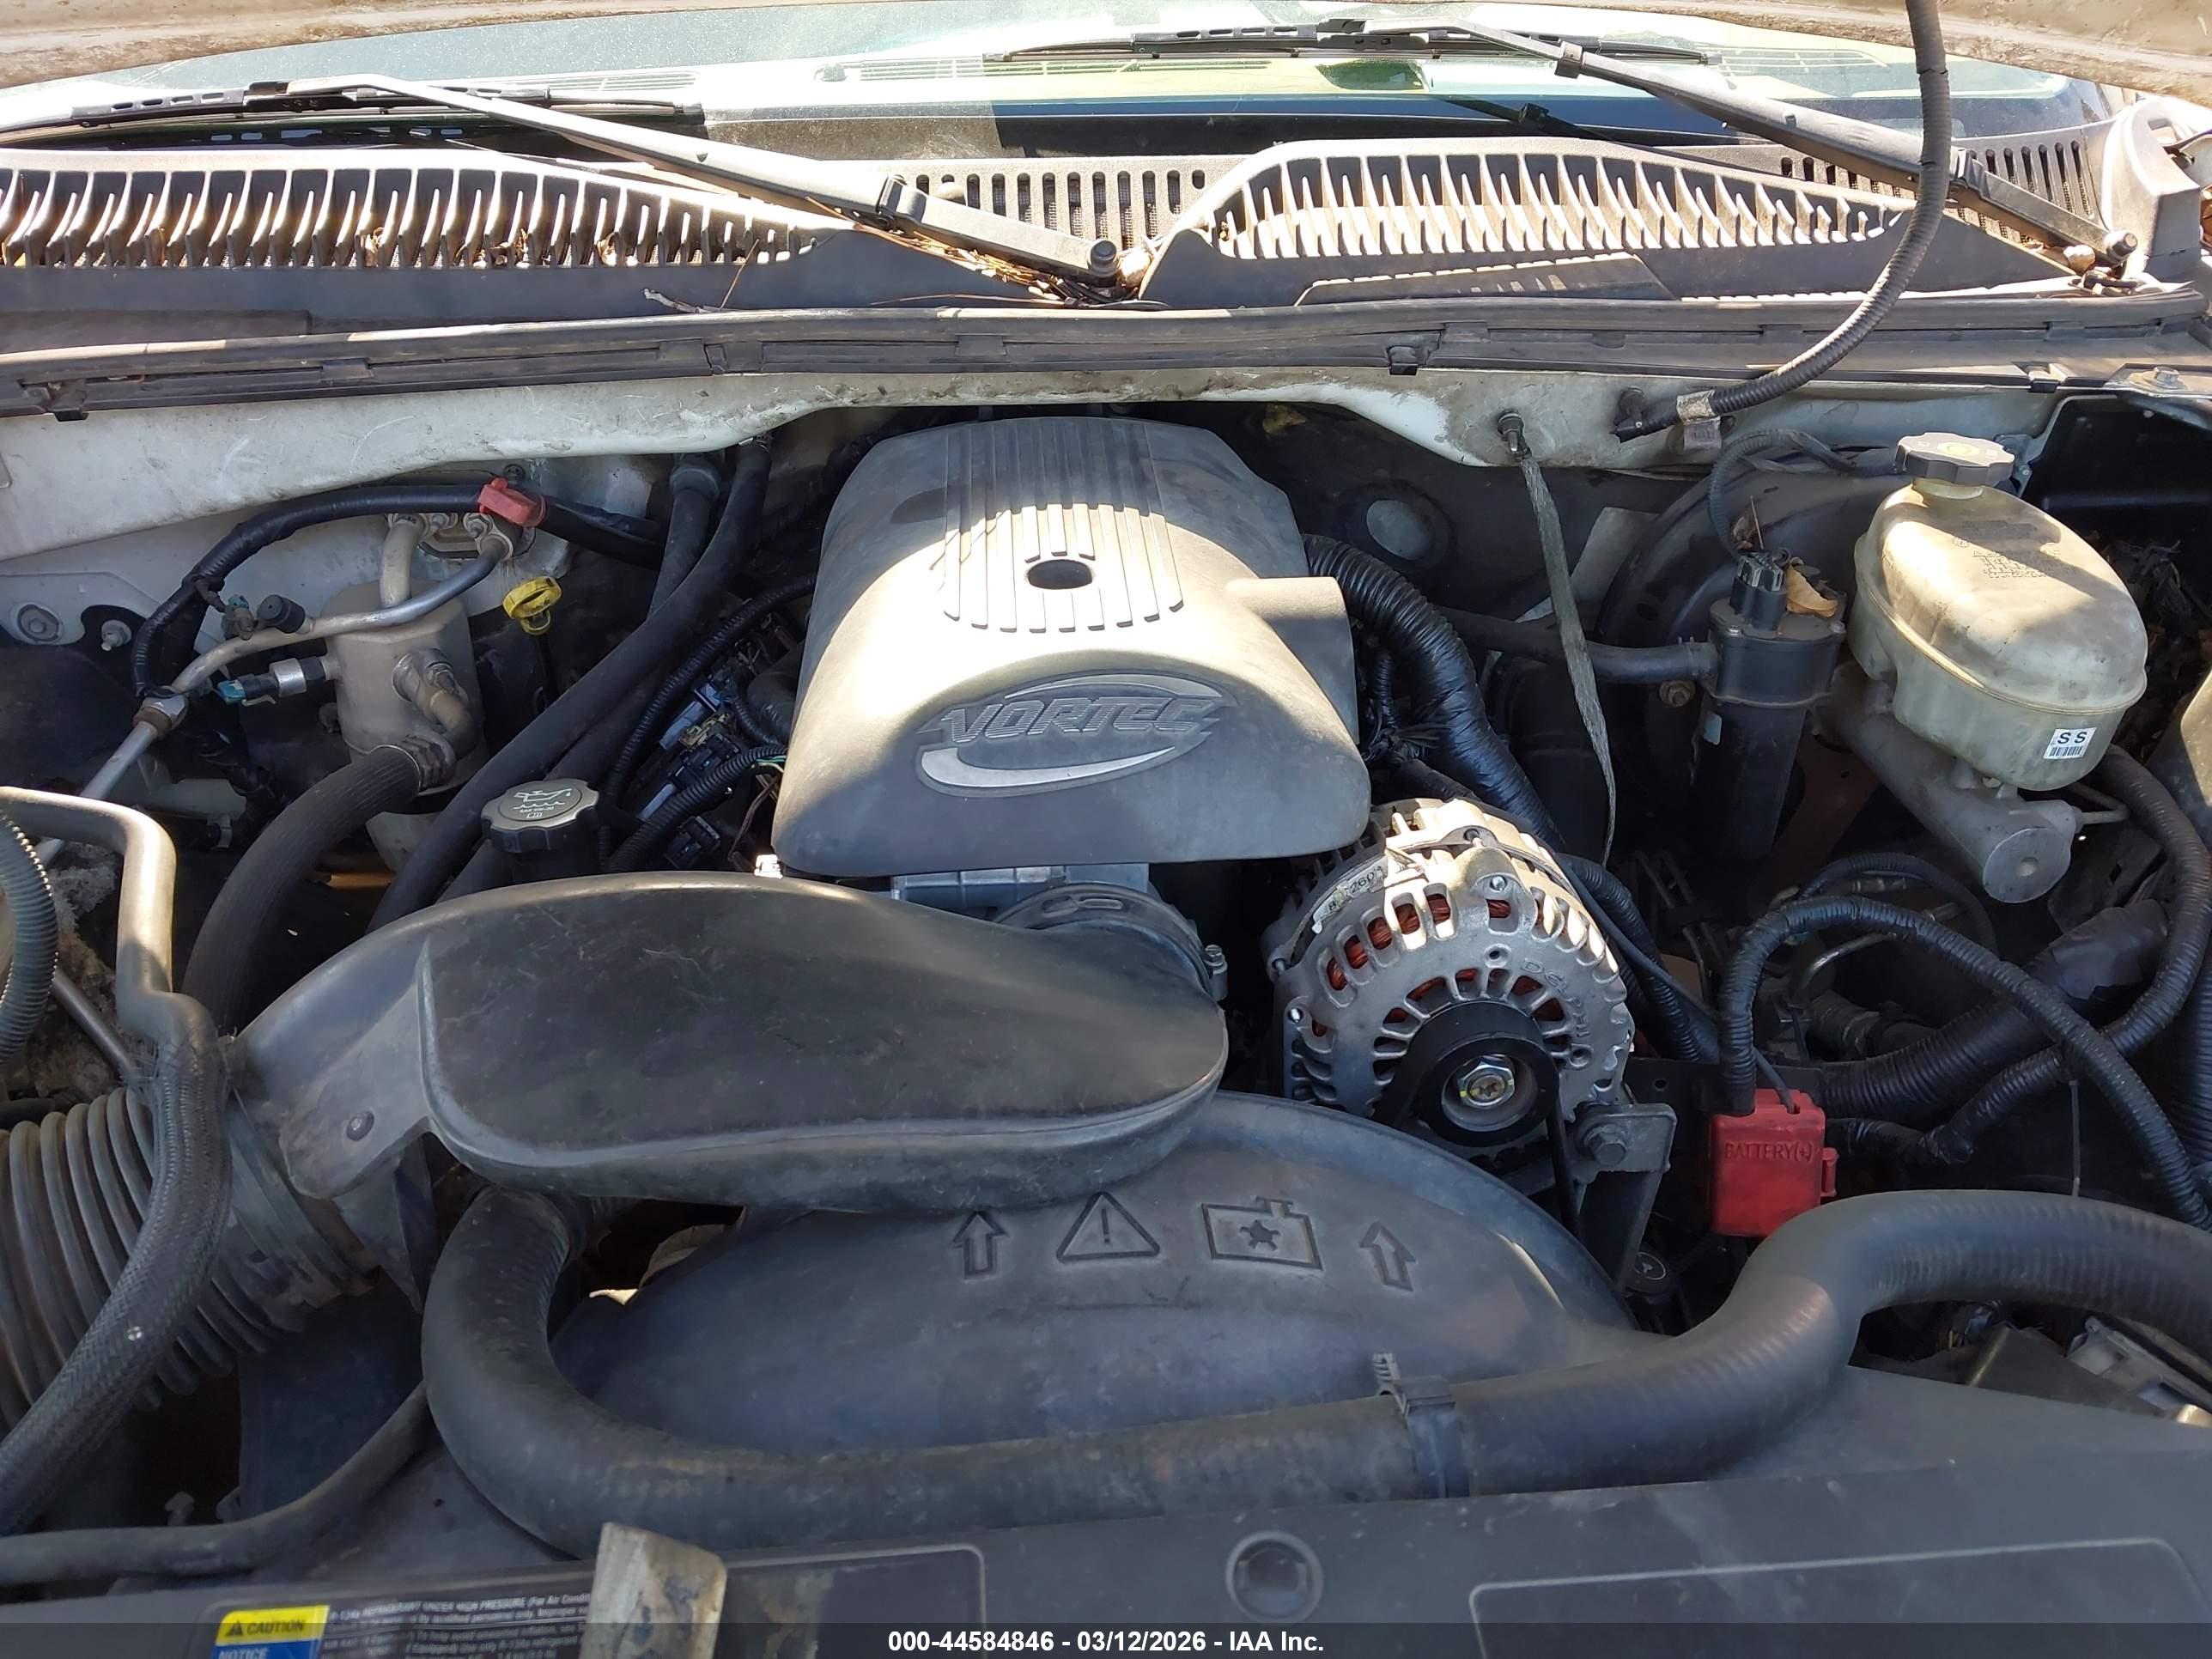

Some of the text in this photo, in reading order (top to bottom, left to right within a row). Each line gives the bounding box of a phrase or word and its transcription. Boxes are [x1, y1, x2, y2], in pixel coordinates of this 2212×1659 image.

[940, 696, 1215, 744] VORTEC
[246, 1619, 306, 1635] CAUTION
[218, 1647, 269, 1659] NOTICE
